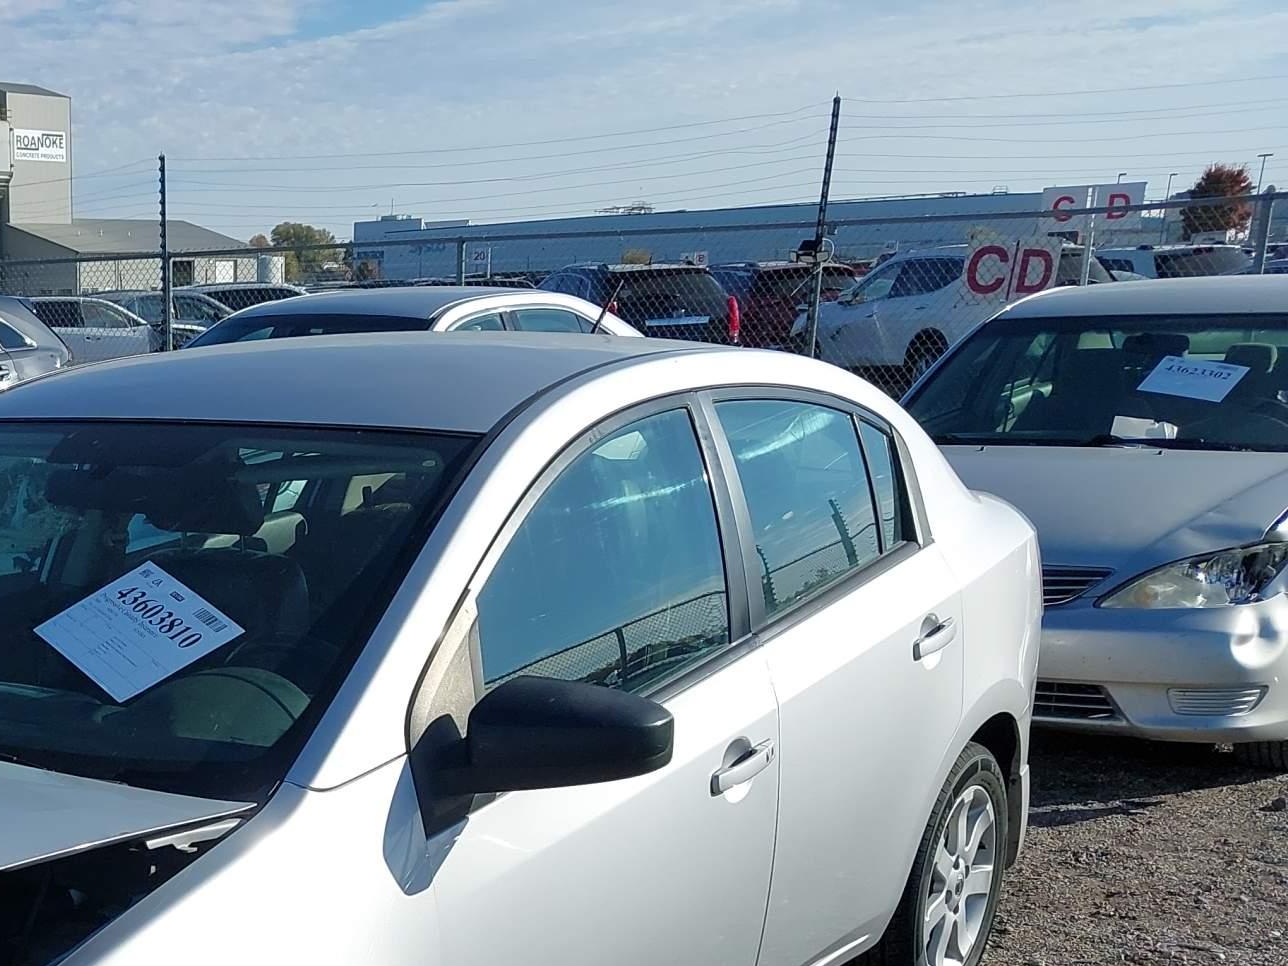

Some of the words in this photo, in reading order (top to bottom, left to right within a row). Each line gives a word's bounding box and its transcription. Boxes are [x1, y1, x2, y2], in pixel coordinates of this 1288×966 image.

[16, 133, 65, 150] ROANOKE
[1052, 195, 1076, 223] C
[1105, 193, 1130, 220] D
[967, 245, 1010, 295] C
[1015, 248, 1054, 294] D
[116, 586, 203, 649] 43603810
